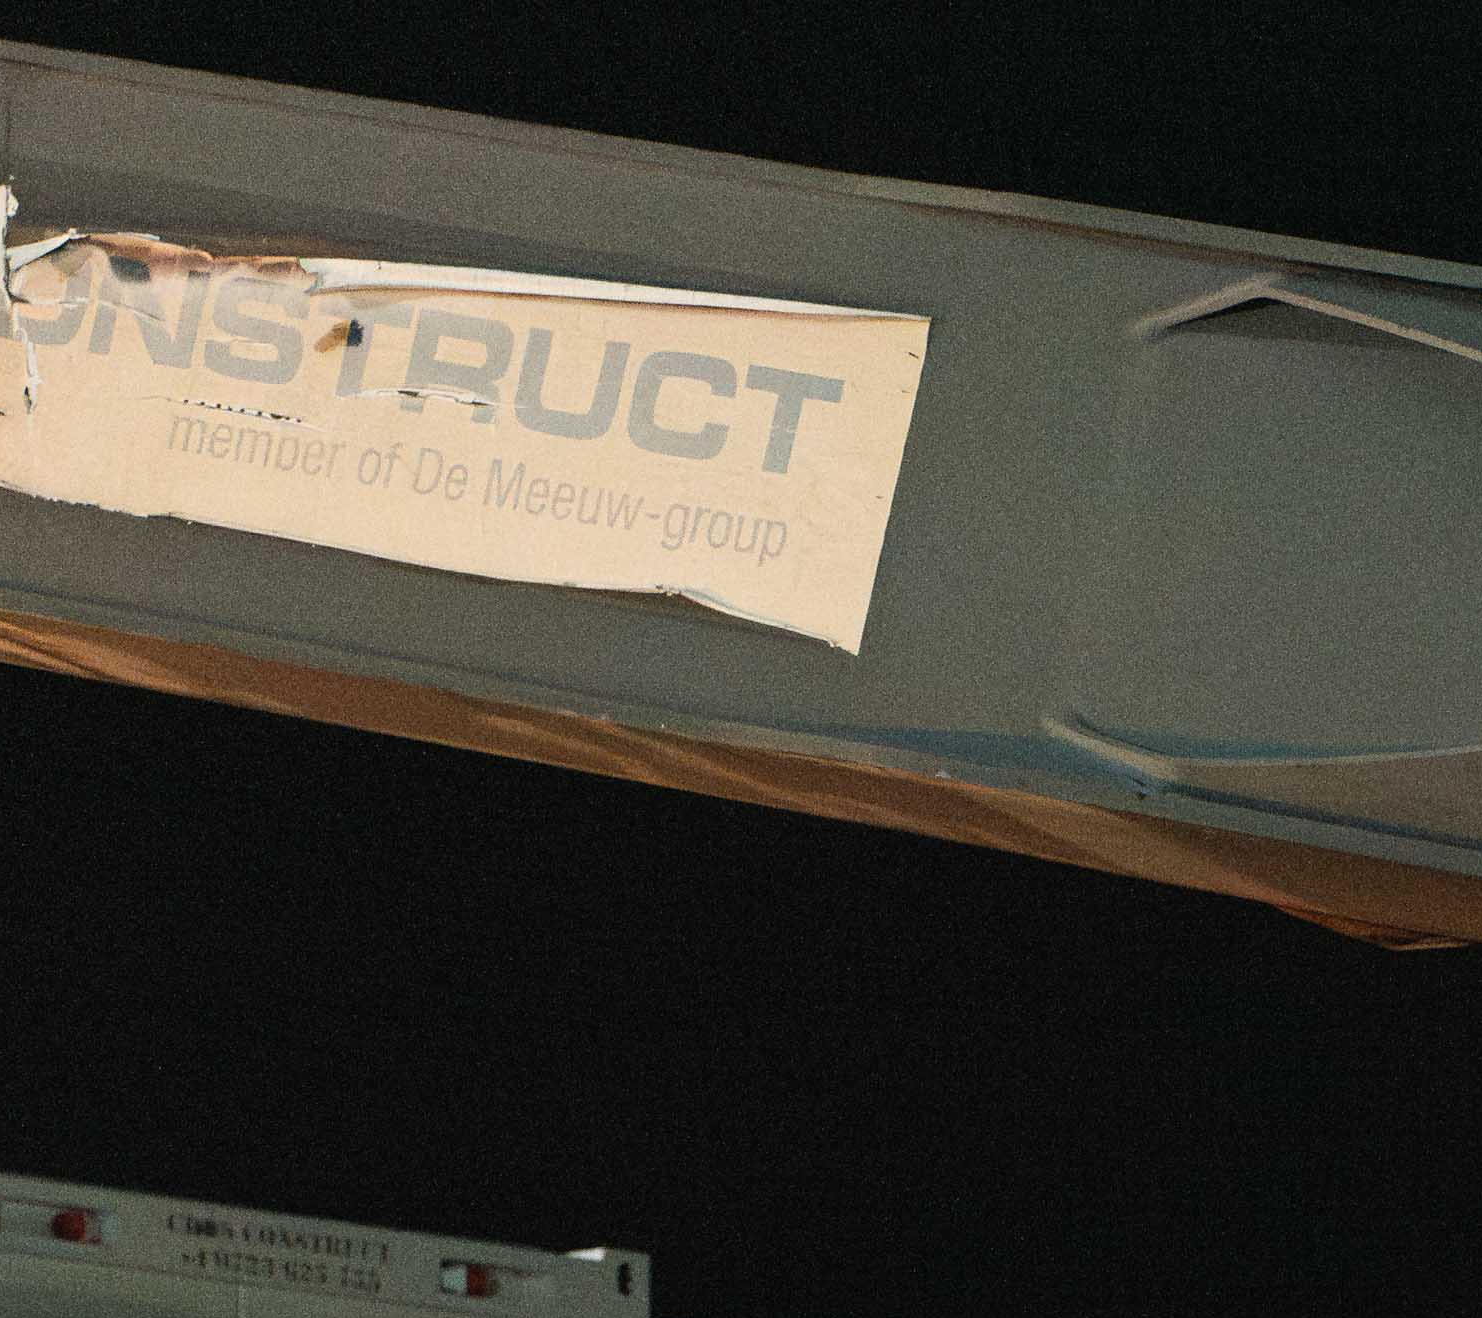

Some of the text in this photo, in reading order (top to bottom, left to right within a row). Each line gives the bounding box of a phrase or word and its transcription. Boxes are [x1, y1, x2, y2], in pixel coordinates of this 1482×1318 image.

[167, 413, 790, 568] member of De Meeuw-group
